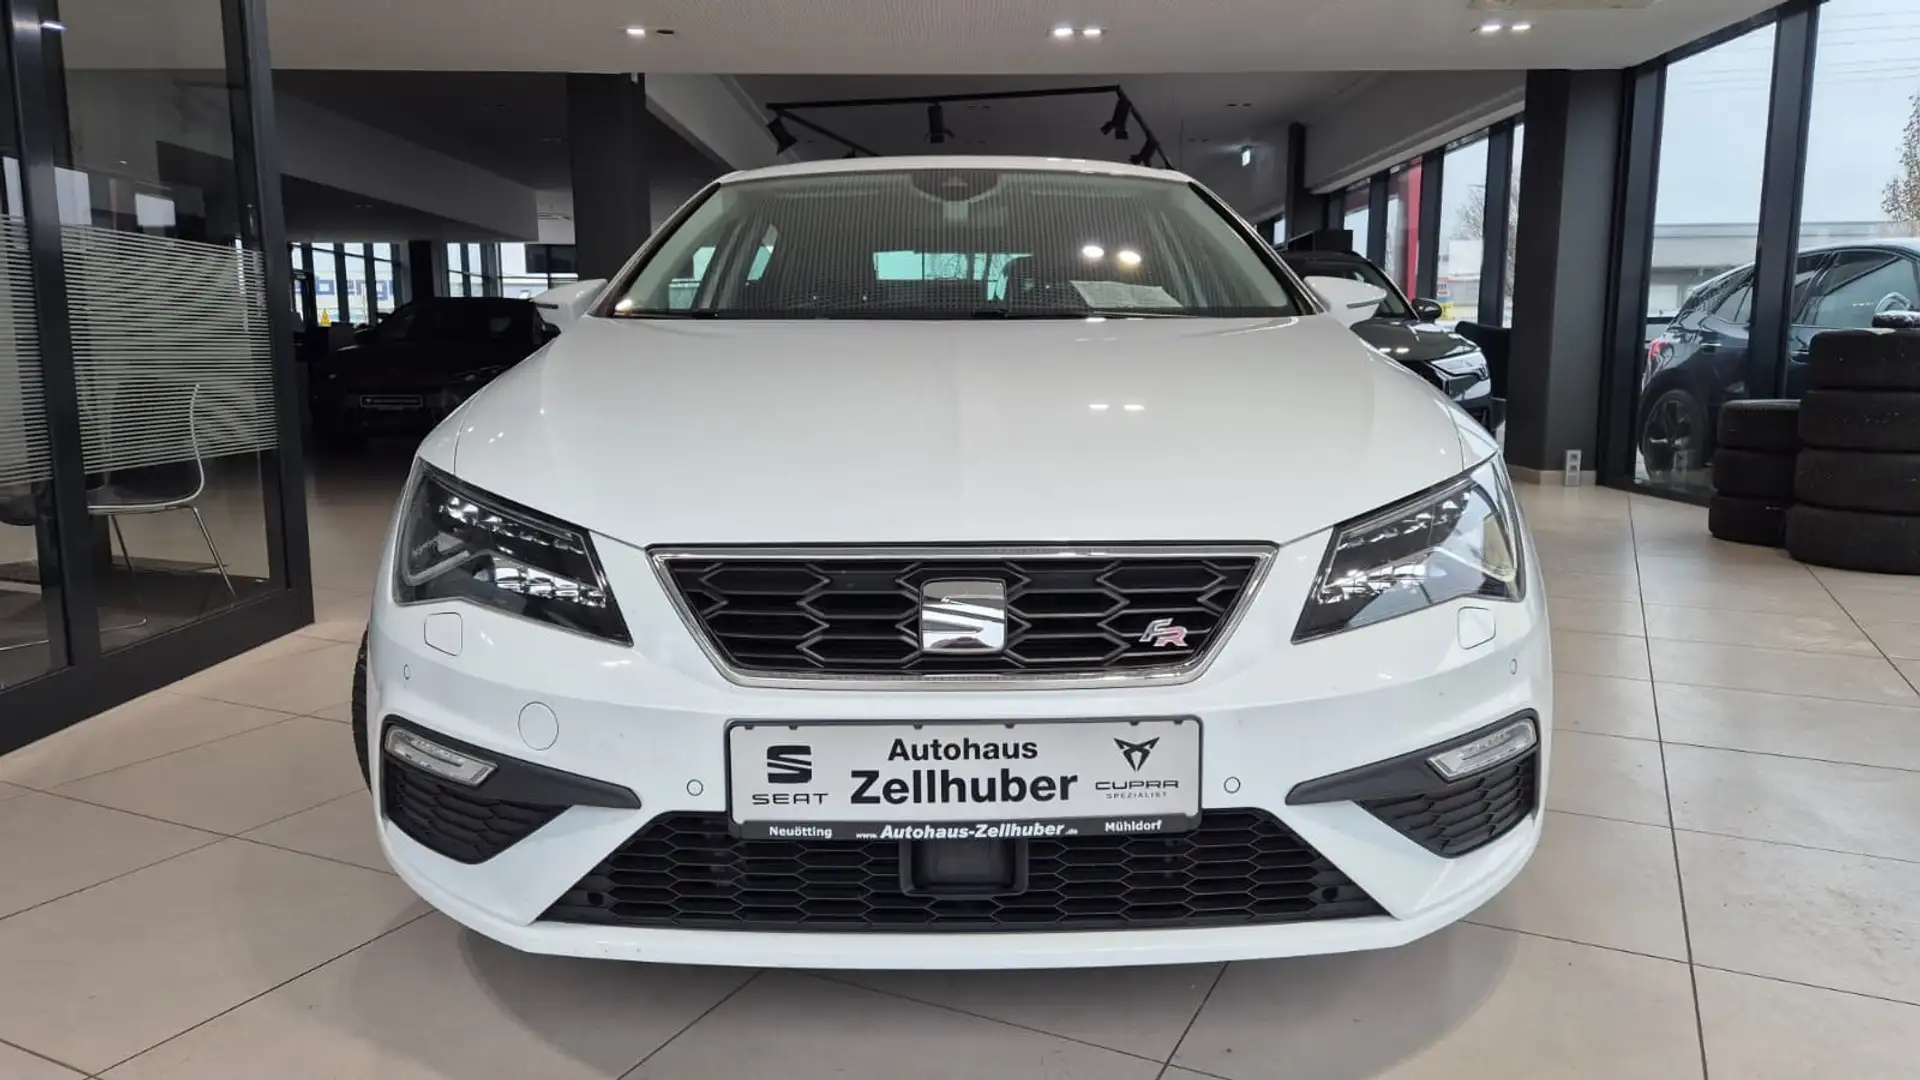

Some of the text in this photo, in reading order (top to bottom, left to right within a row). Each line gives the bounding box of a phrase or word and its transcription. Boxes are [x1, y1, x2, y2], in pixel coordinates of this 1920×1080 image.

[1139, 618, 1188, 647] FR
[888, 738, 1039, 762] Autohaus
[850, 768, 1079, 805] Zellhuber
[1095, 780, 1179, 790] CUPRA
[752, 793, 829, 805] SEAT
[769, 825, 833, 839] Neuötting
[1104, 819, 1163, 833] Mühldorf
